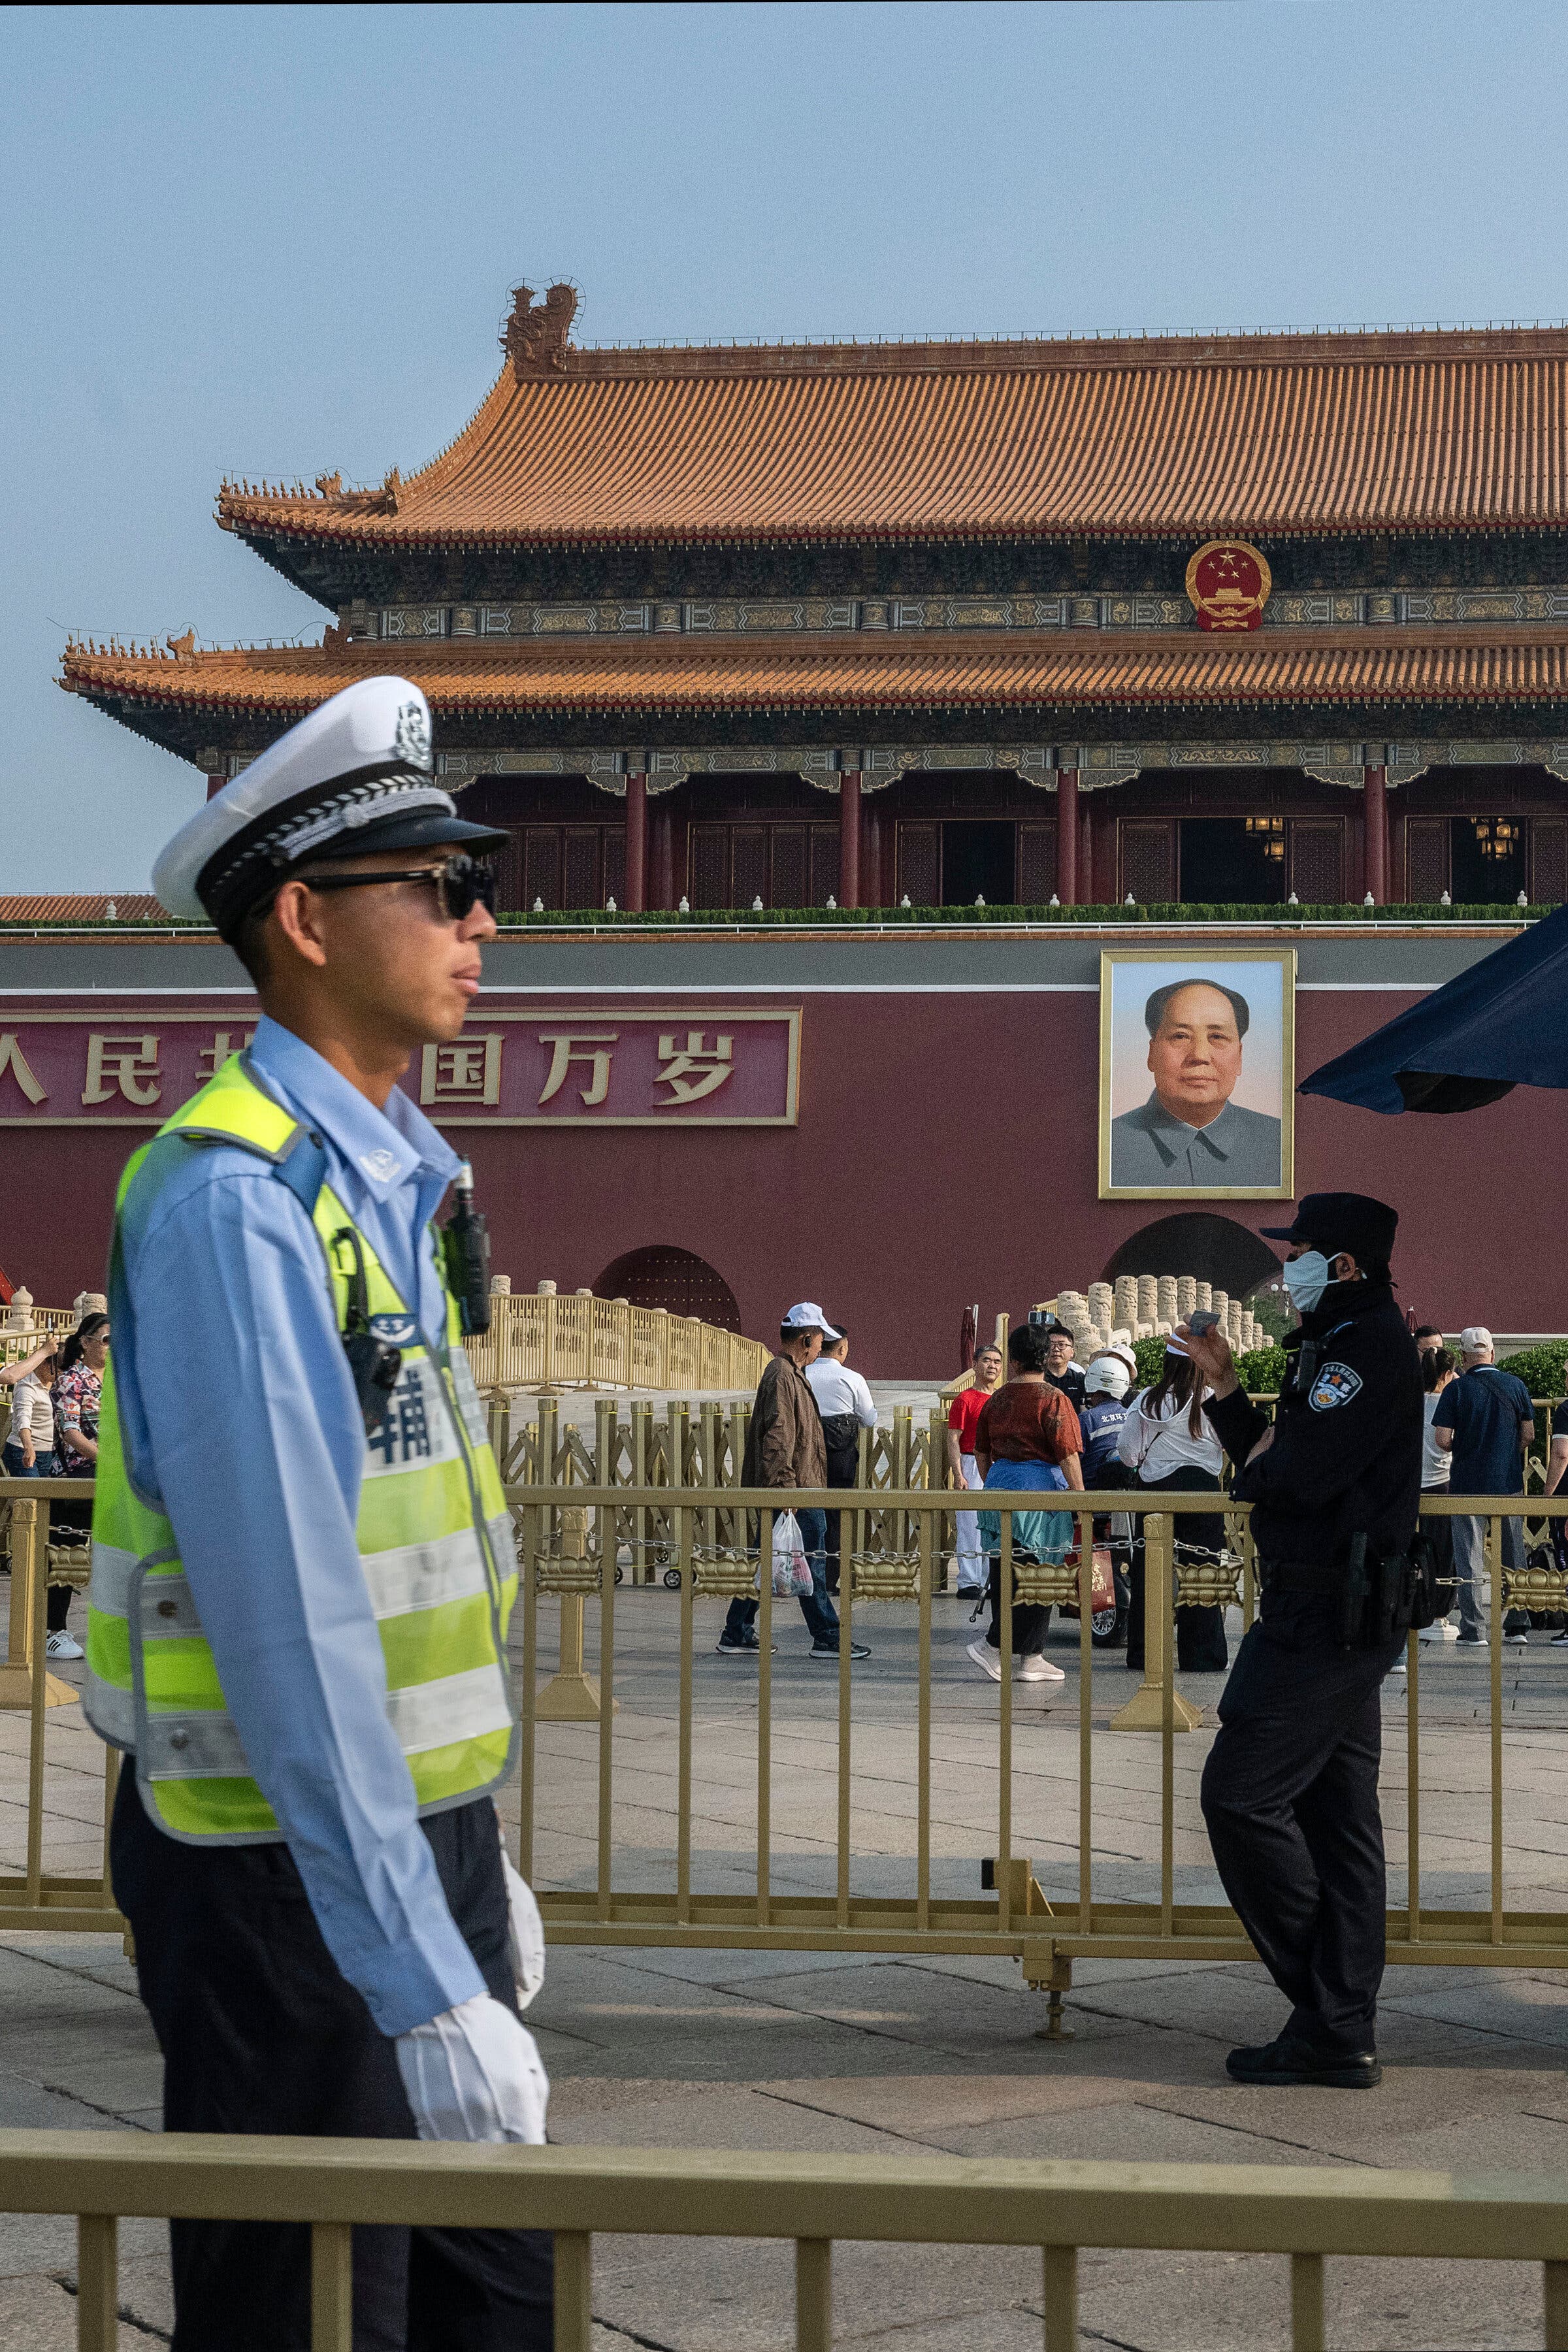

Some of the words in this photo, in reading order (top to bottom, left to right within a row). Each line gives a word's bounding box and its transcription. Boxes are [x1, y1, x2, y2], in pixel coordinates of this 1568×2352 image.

[0, 1031, 735, 1105] 人民国万岁
